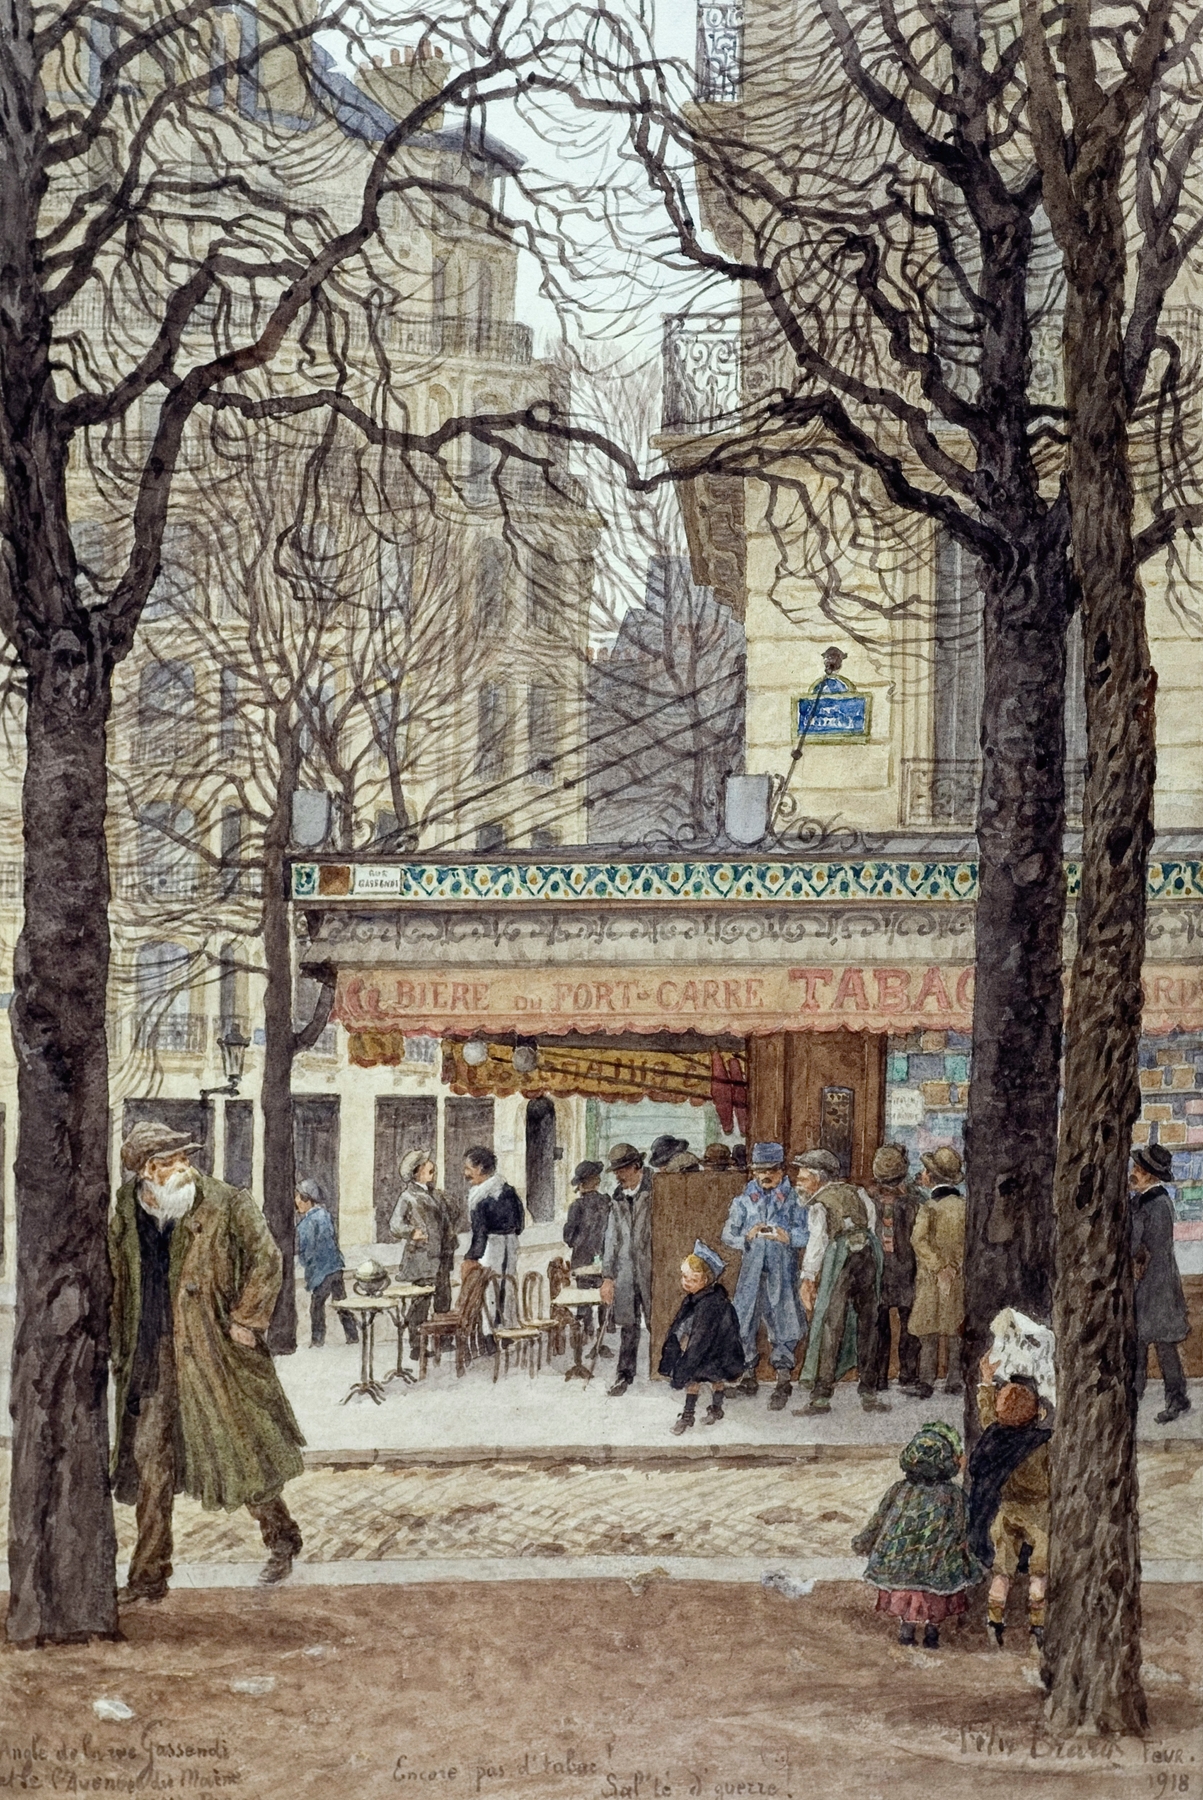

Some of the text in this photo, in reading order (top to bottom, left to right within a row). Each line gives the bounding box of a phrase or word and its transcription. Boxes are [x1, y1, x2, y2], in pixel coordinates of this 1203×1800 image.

[358, 879, 399, 889] GASSENDI
[787, 966, 976, 1014] TABAC
[140, 1720, 230, 1775] Gassendi
[392, 1753, 458, 1782] Encore
[475, 1764, 505, 1793] pas
[1148, 1771, 1190, 1799] 1918
